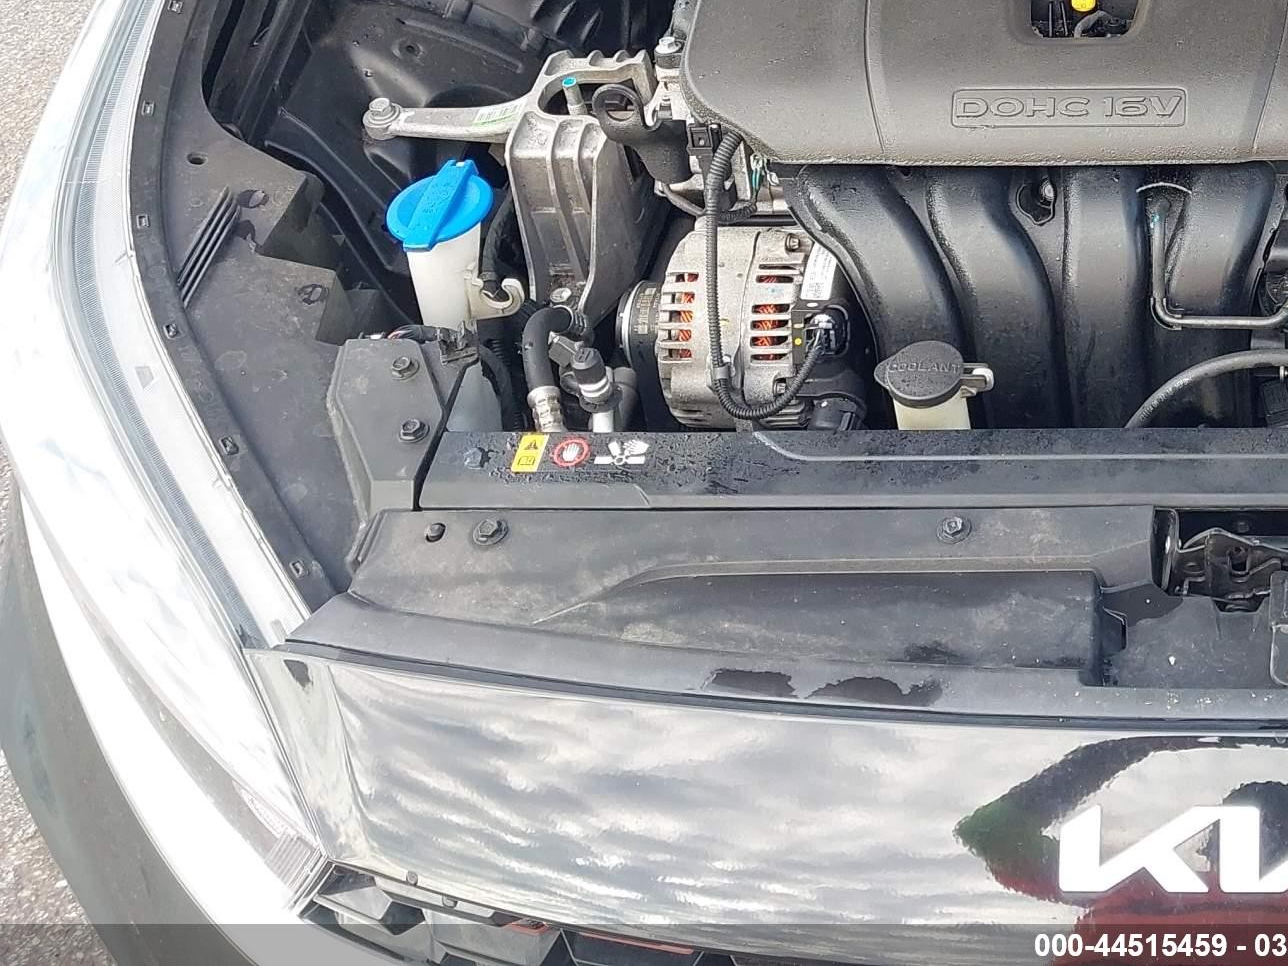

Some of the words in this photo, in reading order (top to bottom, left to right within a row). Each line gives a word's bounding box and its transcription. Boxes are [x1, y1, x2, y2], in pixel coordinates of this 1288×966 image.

[956, 97, 1090, 118] DOHC
[1103, 96, 1183, 118] 16V
[888, 361, 961, 374] COOLANT
